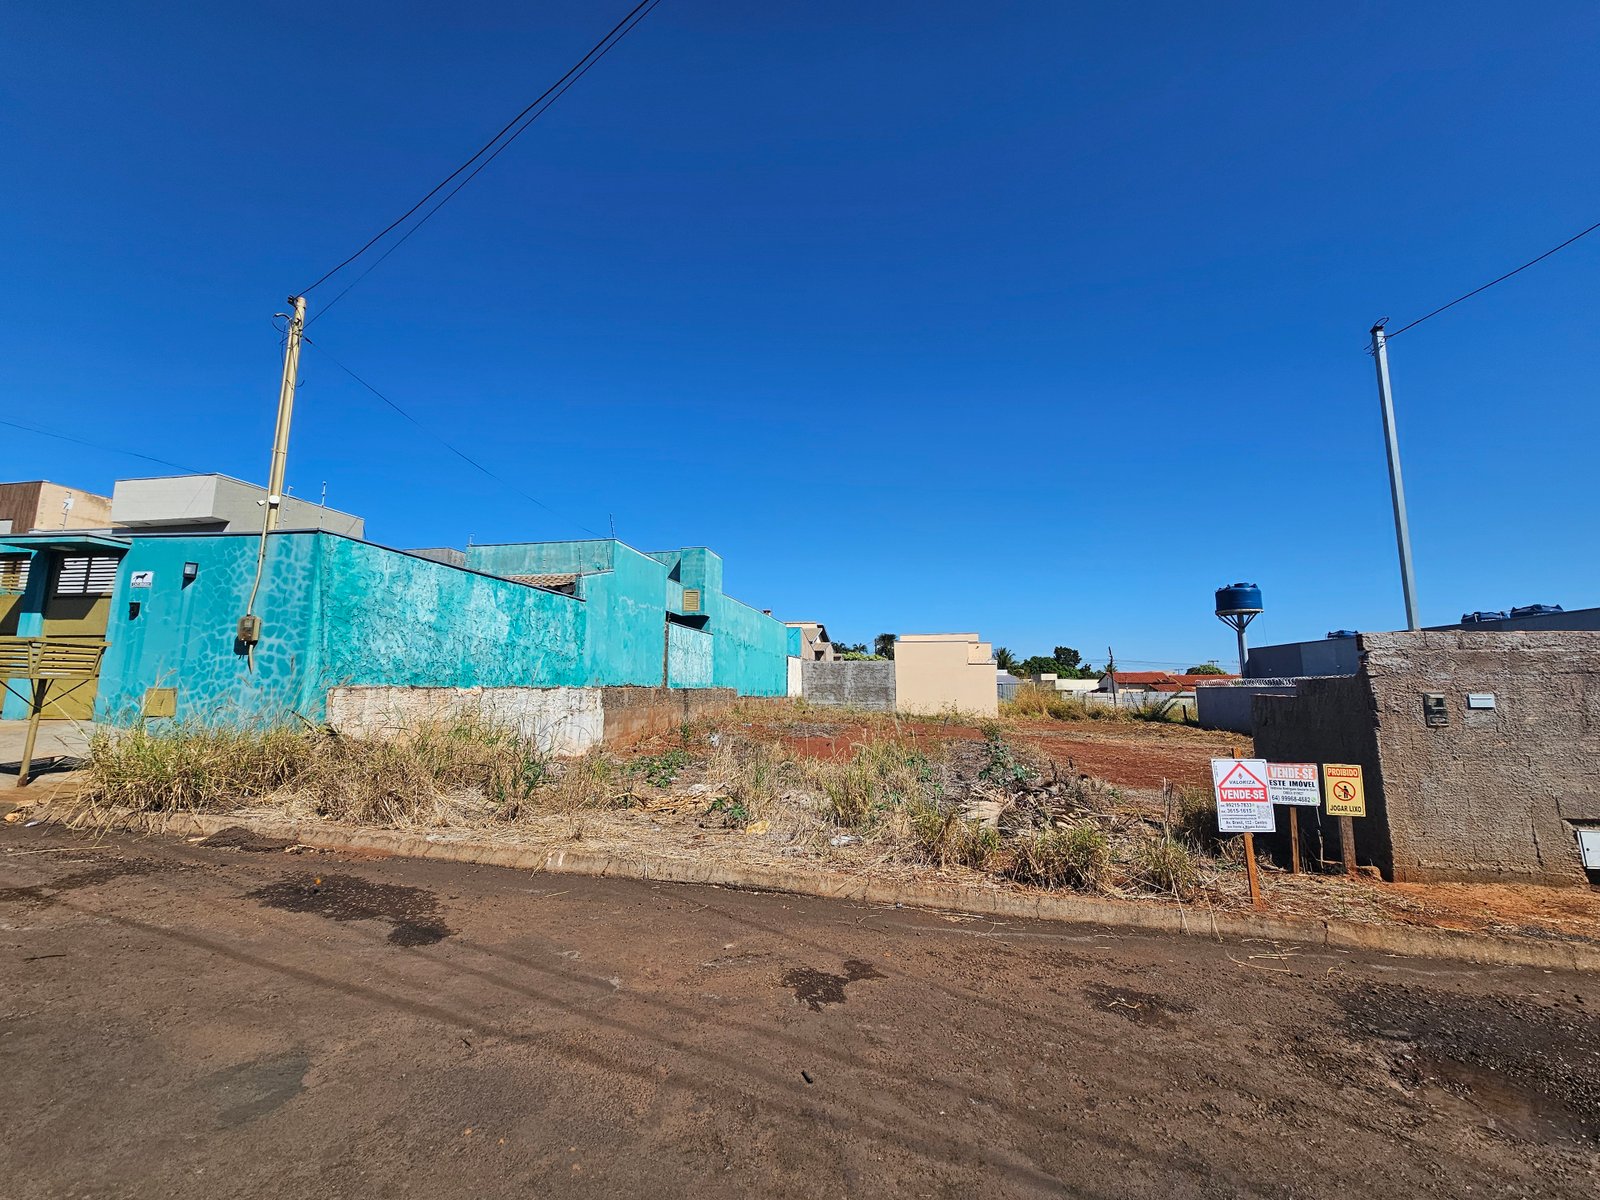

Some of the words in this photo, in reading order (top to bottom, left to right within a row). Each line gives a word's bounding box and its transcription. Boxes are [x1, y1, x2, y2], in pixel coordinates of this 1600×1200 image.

[1271, 767, 1314, 779] VENDE-SE
[1327, 768, 1358, 776] PROIBIDO
[1289, 780, 1315, 788] IMÓVEL
[1221, 789, 1265, 799] VENDE-SE
